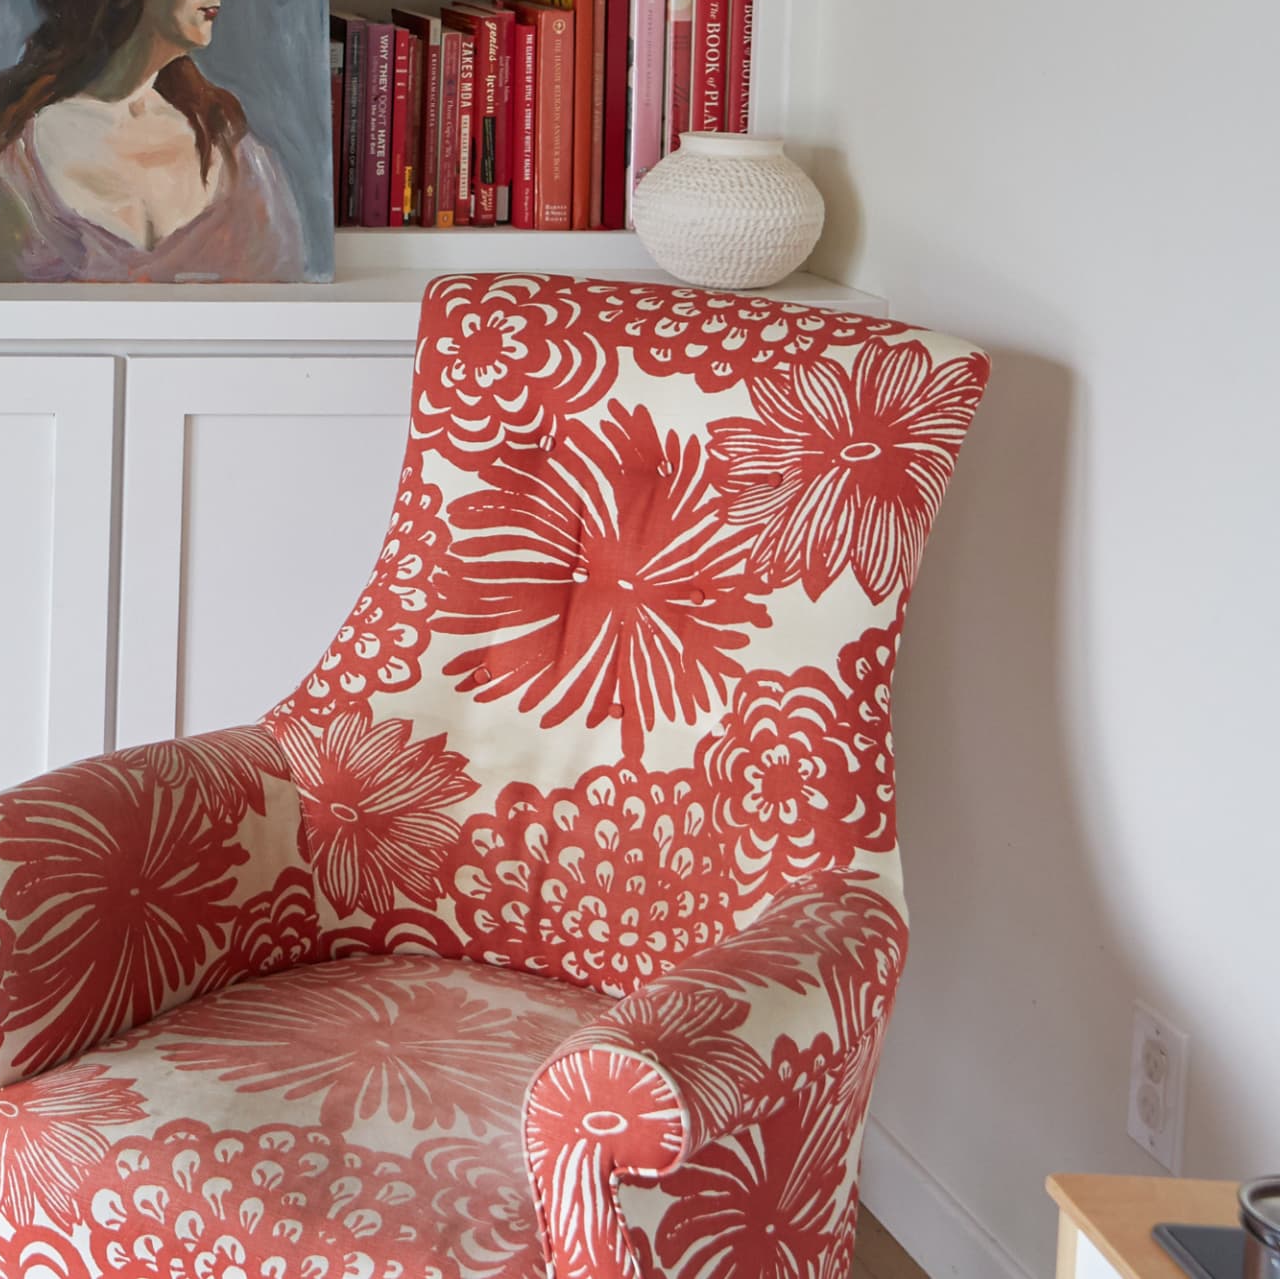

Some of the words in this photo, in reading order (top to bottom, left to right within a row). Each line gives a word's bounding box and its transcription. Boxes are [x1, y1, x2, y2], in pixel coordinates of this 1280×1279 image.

[704, 2, 720, 18] The
[376, 35, 389, 60] WHY
[460, 41, 474, 79] ZAKES
[704, 23, 720, 73] BOOK
[376, 63, 389, 91] THEY
[704, 76, 720, 87] of
[460, 83, 474, 108] MDA
[376, 95, 389, 126] DON'T
[704, 90, 720, 132] PLAN
[376, 129, 389, 157] HATE
[376, 161, 389, 176] US
